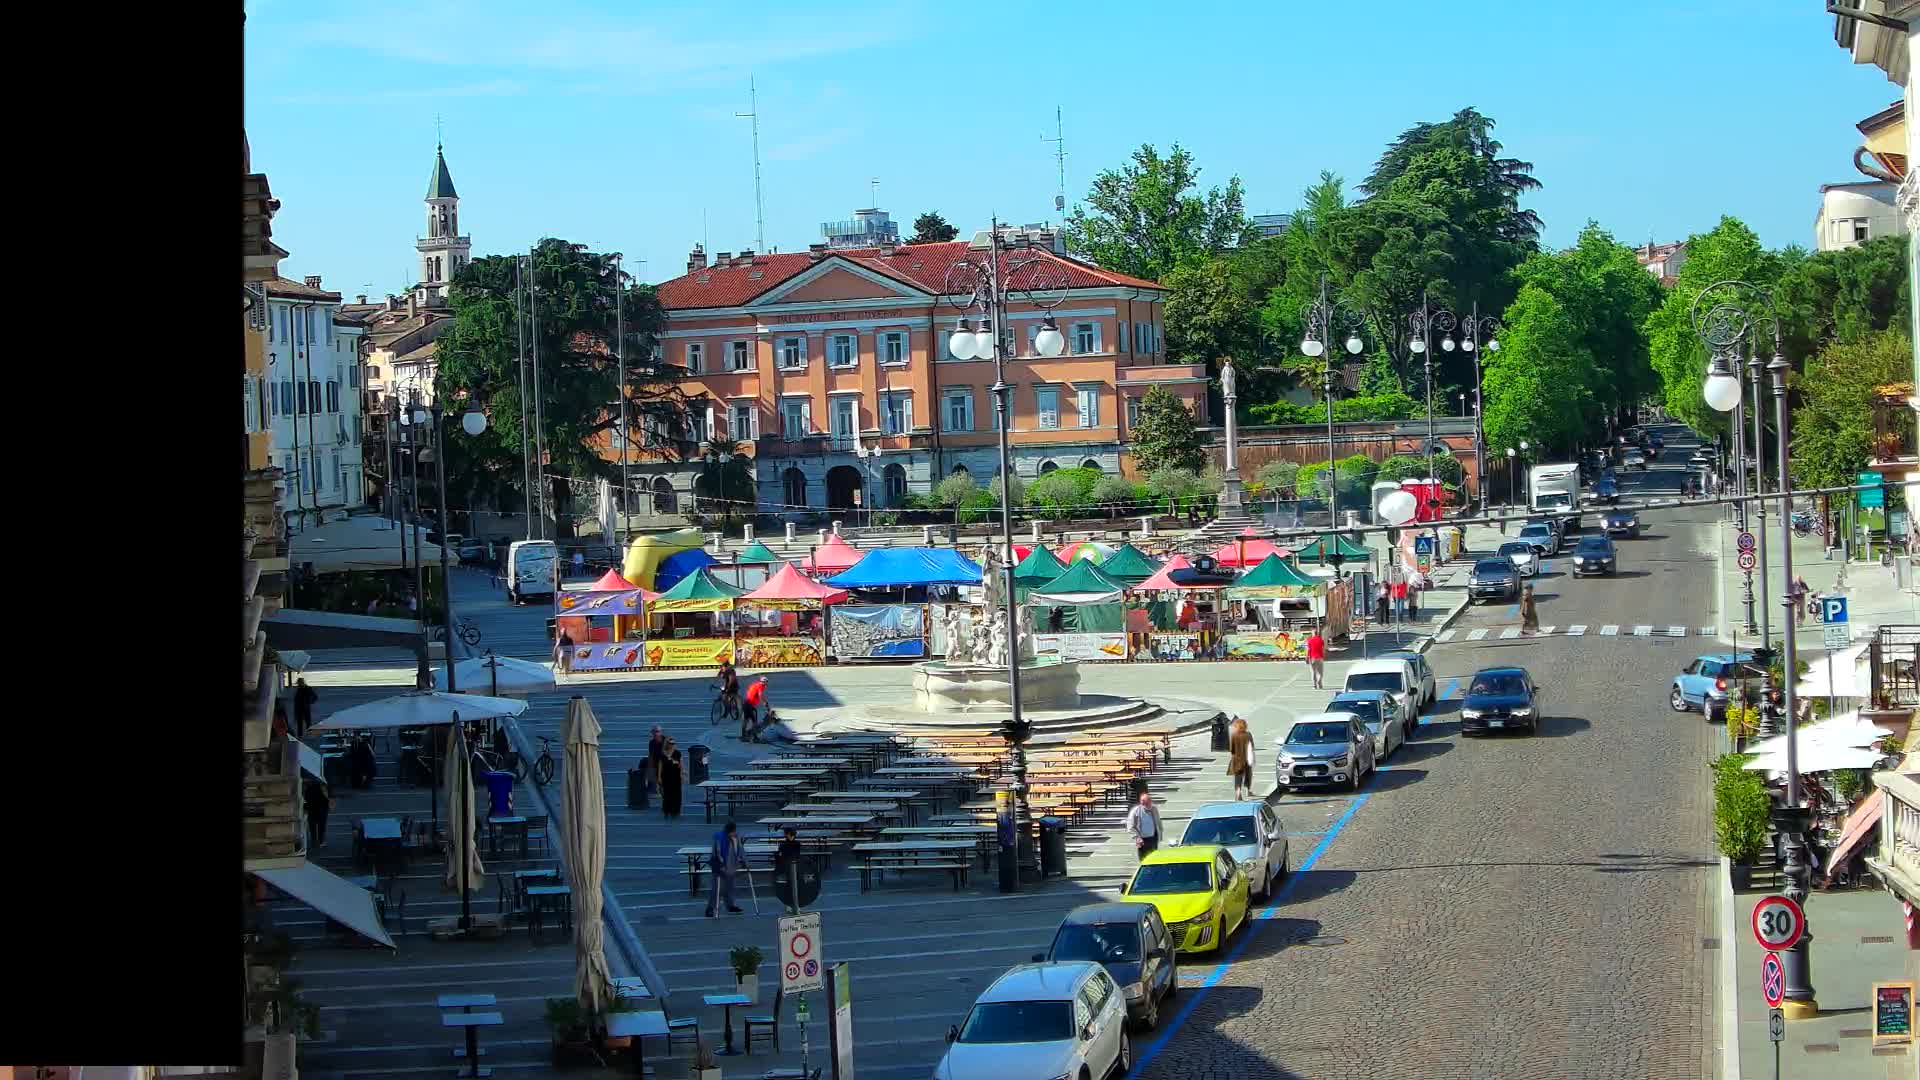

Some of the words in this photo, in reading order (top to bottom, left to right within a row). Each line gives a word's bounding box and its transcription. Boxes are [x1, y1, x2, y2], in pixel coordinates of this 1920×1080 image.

[1741, 556, 1753, 565] 20
[1827, 601, 1842, 620] P
[1762, 910, 1791, 936] 30
